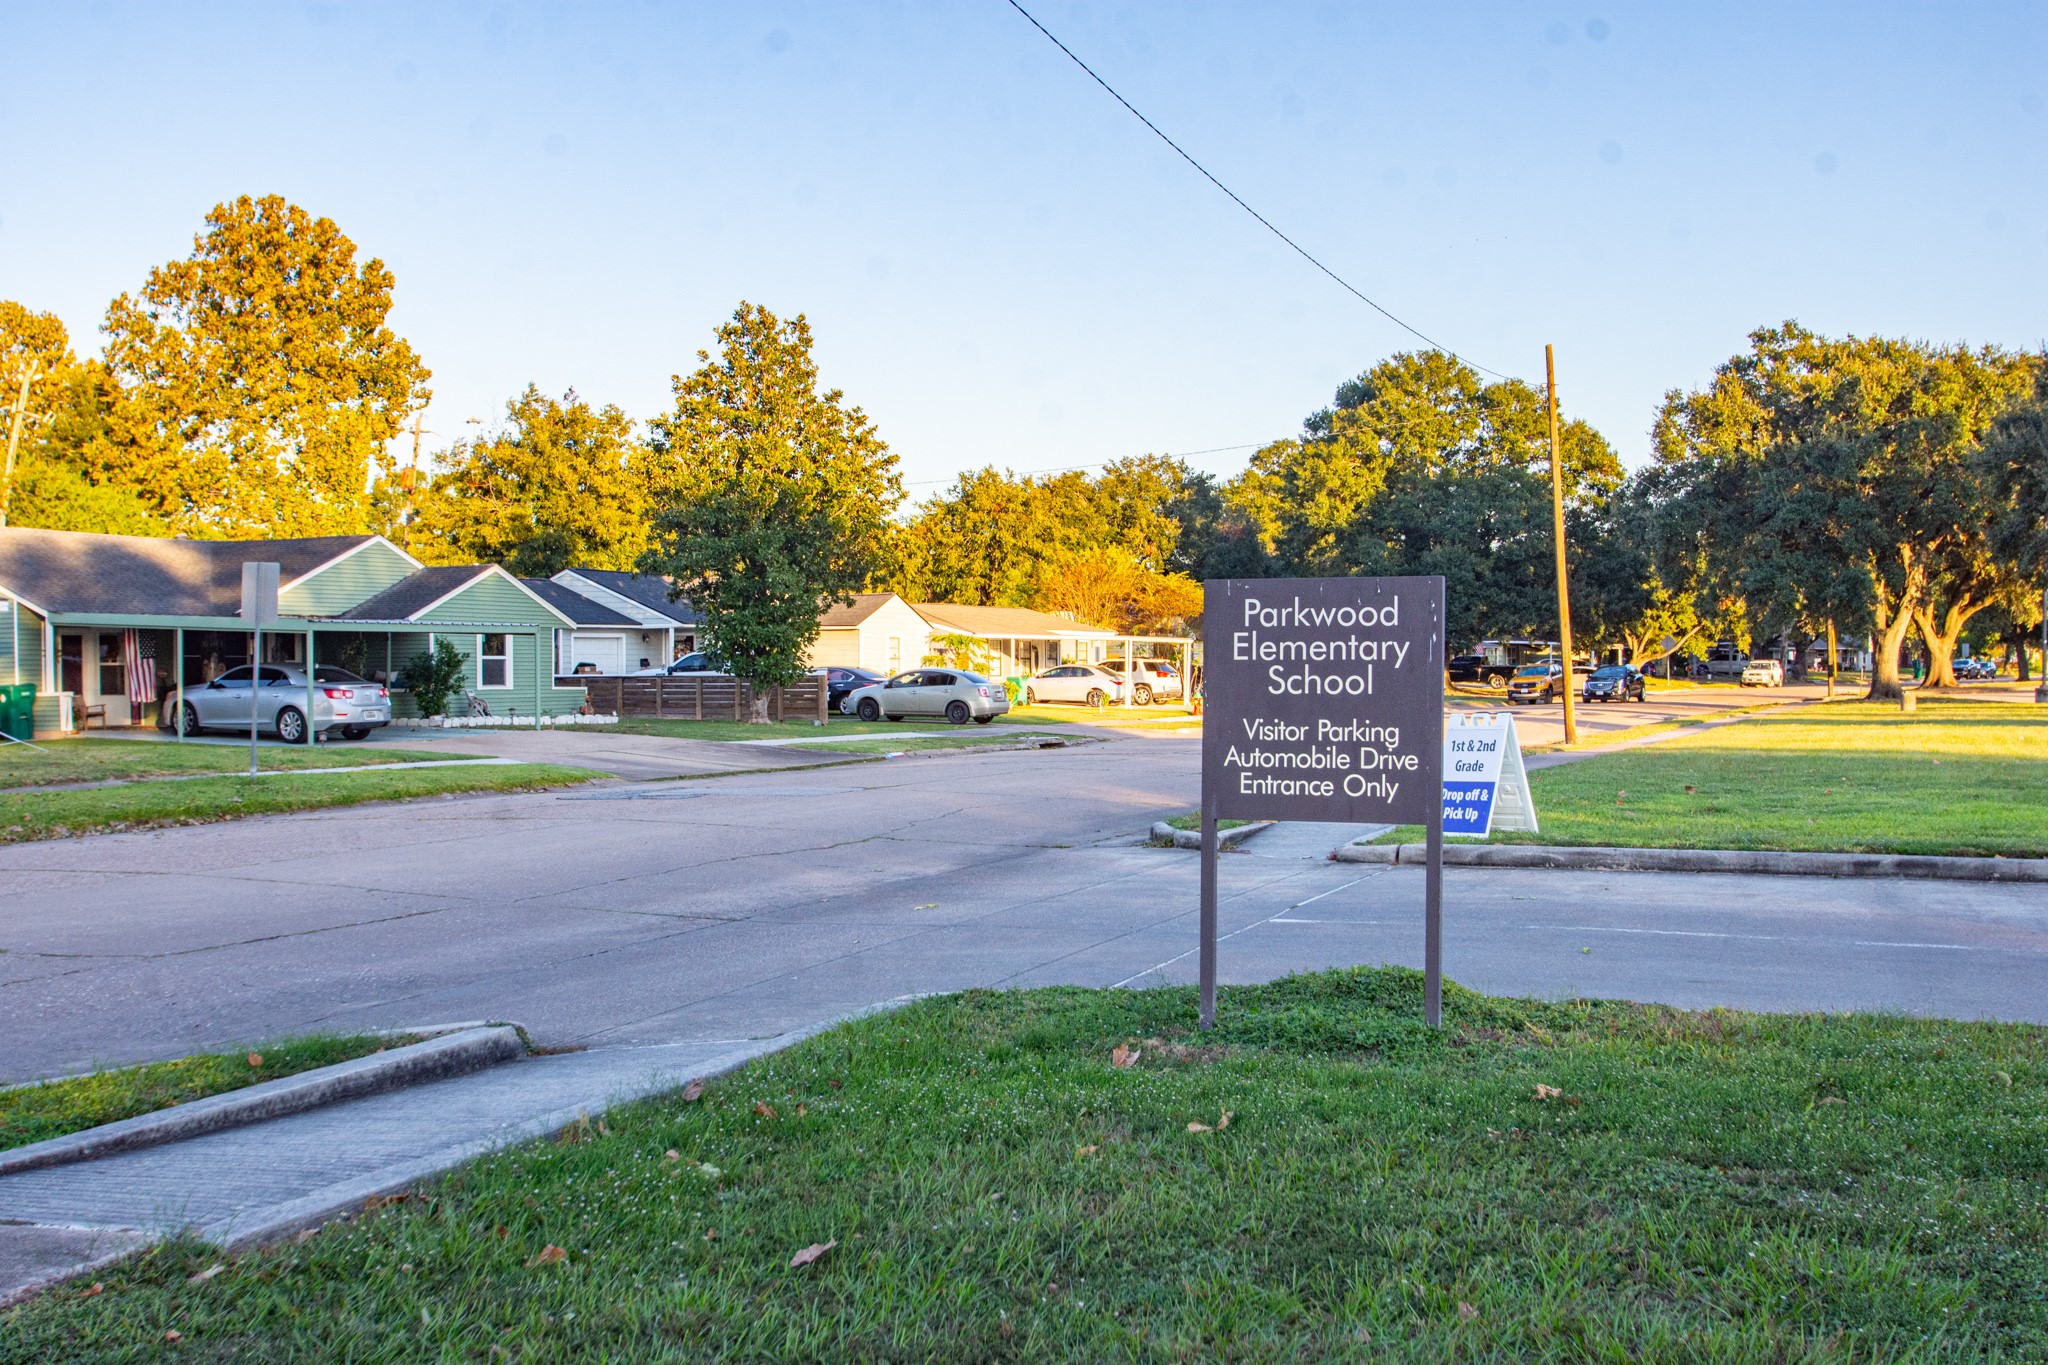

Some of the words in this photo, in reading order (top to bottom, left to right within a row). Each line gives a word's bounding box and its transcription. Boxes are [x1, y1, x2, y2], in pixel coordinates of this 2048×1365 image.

[1244, 595, 1399, 627] Parkwood
[1233, 631, 1410, 669] Elementary
[1268, 664, 1373, 695] School
[1243, 718, 1309, 741] Visitor
[1318, 718, 1399, 748] Parking
[1451, 740, 1465, 752] 1st
[1467, 740, 1474, 751] &
[1477, 740, 1496, 752] 2nd
[1223, 745, 1350, 769] Automobile
[1360, 747, 1419, 770] Drive
[1455, 760, 1484, 772] Grade
[1240, 772, 1334, 797] Entrance
[1344, 774, 1399, 804] Only
[1465, 788, 1480, 801] off
[1480, 789, 1488, 801] &
[1443, 807, 1463, 819] Pick
[1465, 808, 1478, 822] Up
